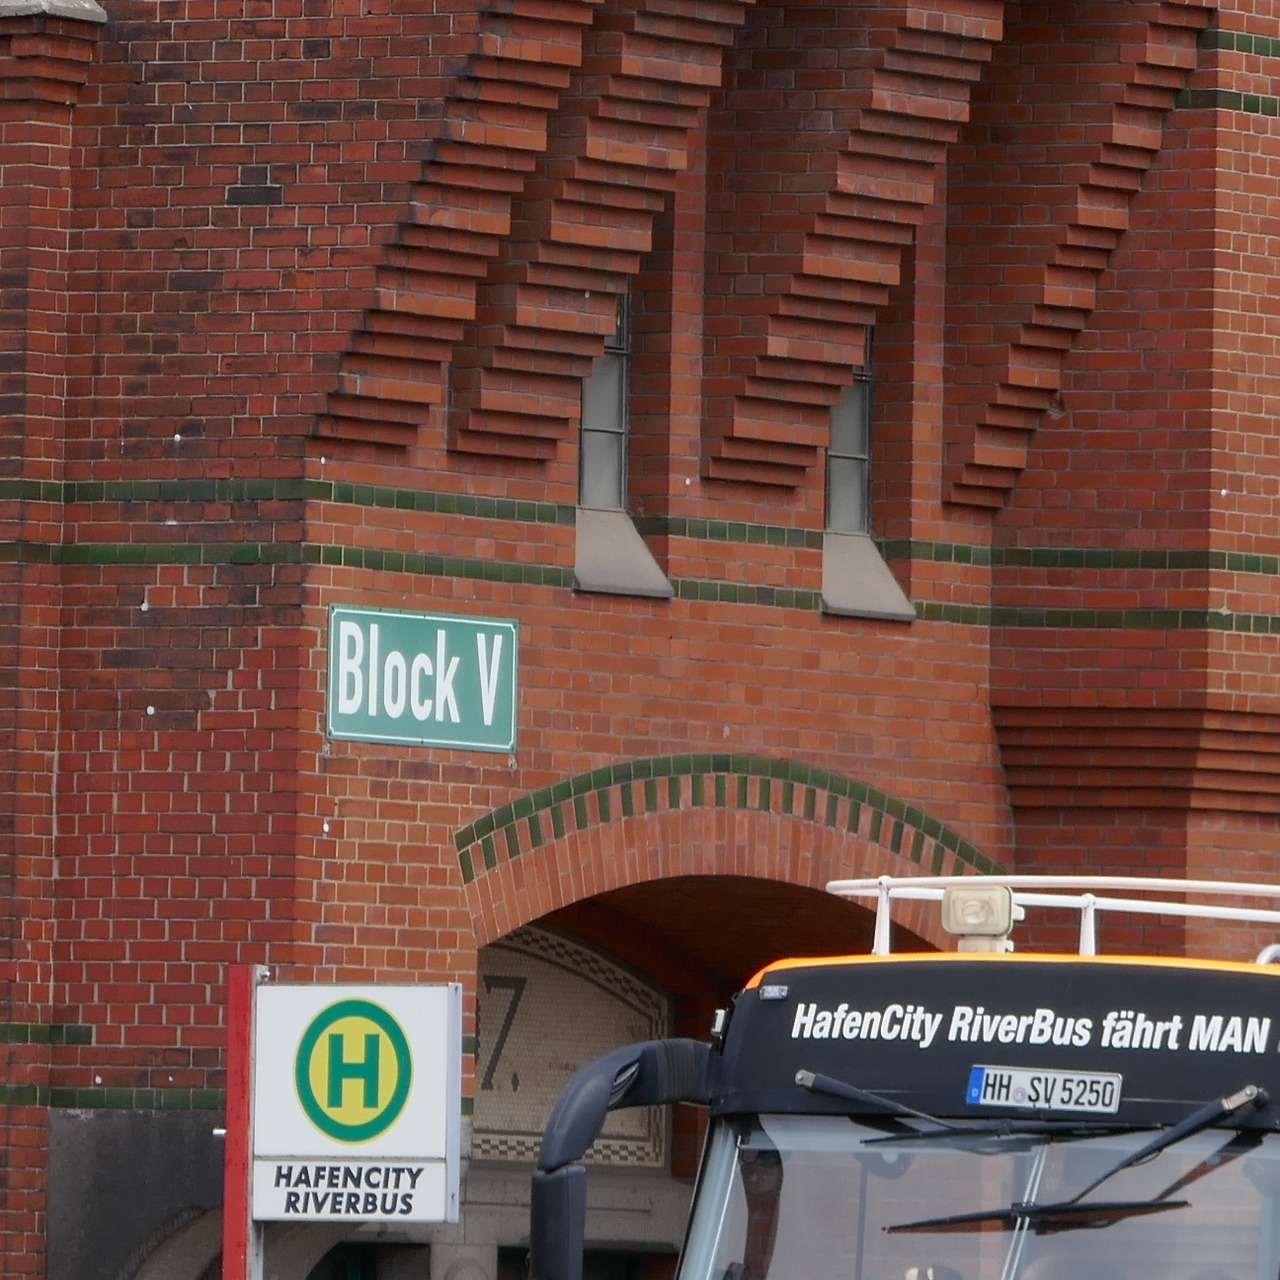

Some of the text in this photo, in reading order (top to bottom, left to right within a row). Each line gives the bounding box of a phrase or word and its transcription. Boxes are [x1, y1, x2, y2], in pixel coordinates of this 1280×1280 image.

[338, 620, 503, 726] Block V
[791, 1003, 1271, 1054] HafenCity RiverBus fährt MAN
[982, 1072, 1012, 1101] HH
[1028, 1076, 1057, 1106] SV
[1060, 1078, 1115, 1108] 5250
[274, 1165, 424, 1190] HAFENCITY
[284, 1191, 413, 1215] RIVERBUS
